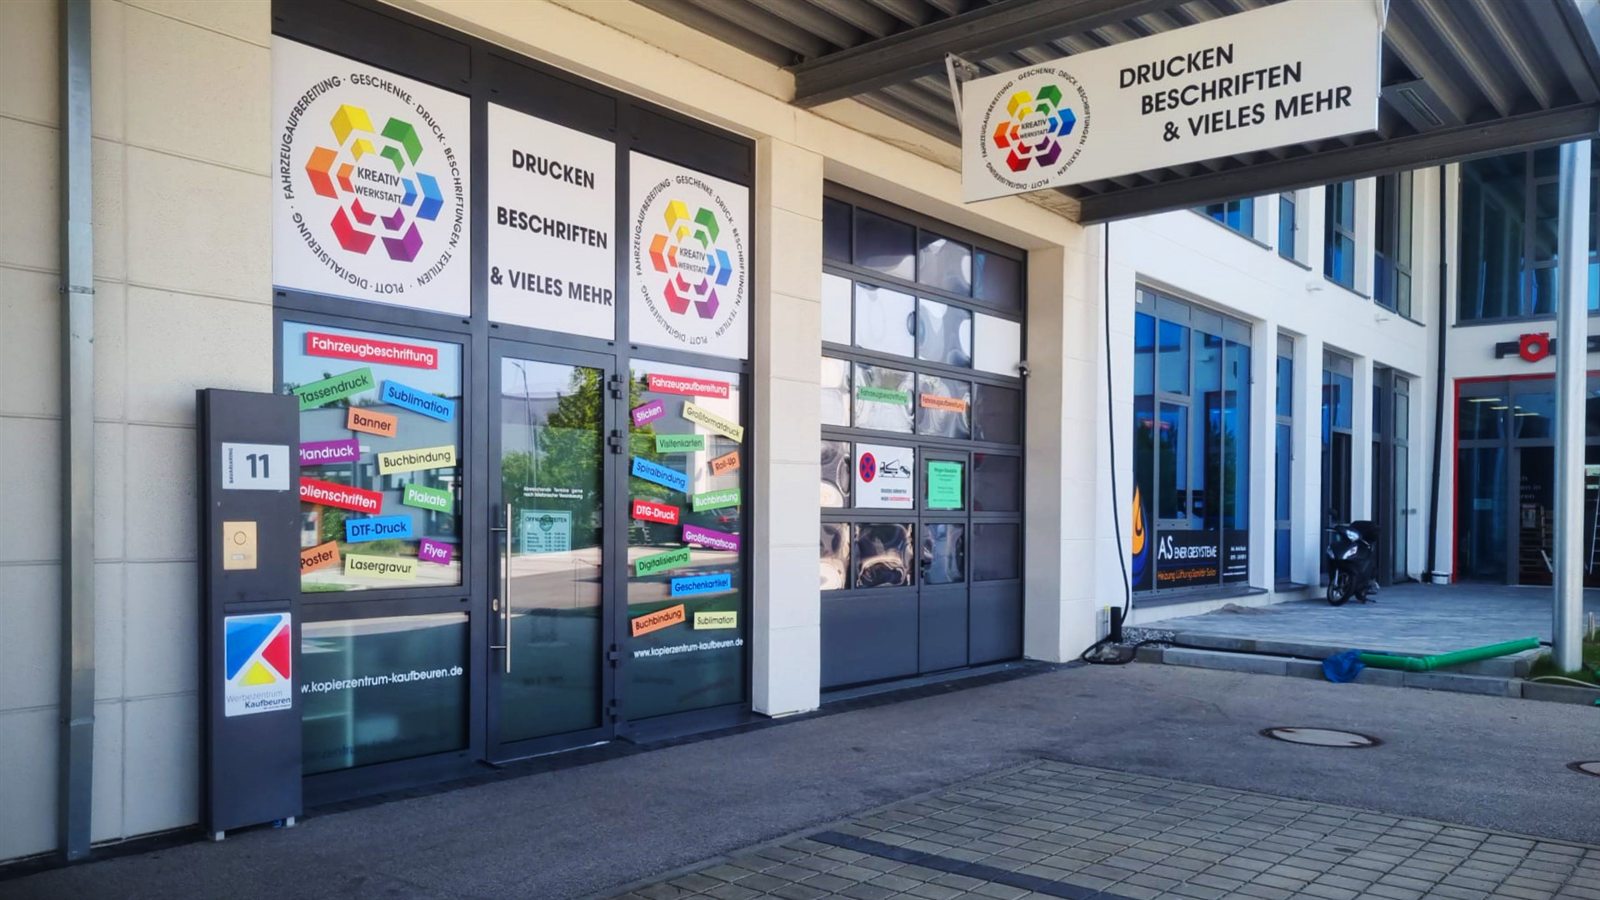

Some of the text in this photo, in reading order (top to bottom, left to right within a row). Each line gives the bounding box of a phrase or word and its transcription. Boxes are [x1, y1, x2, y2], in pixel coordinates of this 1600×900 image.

[1119, 43, 1234, 89] DRUCKEN
[1141, 61, 1302, 116] BESCHRIFTEN
[1162, 85, 1353, 143] & VIELES MEHR
[1021, 119, 1048, 130] KREATIV
[357, 166, 400, 187] KREATIV
[512, 149, 595, 190] DRUCKEN
[279, 73, 464, 294] FAHRZEUGAUFBEREITUNG GESCHENKE DRUCK BESCHRIFTUNGEN TEXTILIEN PLOTT DIGITALISIERUNG
[354, 185, 402, 204] WERKSTATT
[675, 175, 714, 198] GESCHENKE
[715, 195, 733, 220] DRUCK
[496, 206, 608, 249] BESCHRIFTEN
[679, 247, 706, 262] KREATIV
[490, 266, 613, 307] & VIELES MEHR
[312, 337, 434, 365] Fahrzeugbeschriftung
[300, 375, 369, 404] Tassendruck
[652, 377, 727, 396] Fahrzeugaufbereitung
[388, 386, 450, 417] Sublimation
[353, 413, 392, 431] Banner
[660, 439, 703, 449] Visitenkarten
[246, 454, 269, 478] 11
[383, 451, 451, 468] Buchbindung
[637, 462, 686, 489] Spiralbindung
[300, 485, 377, 509] olienschriften
[408, 489, 447, 507] Plakate
[695, 493, 738, 507] Buchbindung
[636, 505, 675, 521] DTG-Druck
[351, 521, 407, 537] DTF-Druck
[685, 531, 737, 550] Großformatscan
[1158, 535, 1173, 560] AS
[300, 549, 334, 570] Poster
[423, 543, 448, 559] Flyer
[350, 559, 412, 575] Lasergravur
[639, 552, 688, 571] Digitalisierung
[675, 579, 728, 592] Geschenkartikel
[635, 608, 682, 630] Buchbindung
[697, 616, 735, 625] Sublimation
[634, 638, 743, 658] www.kopierzentrum-kaufbeuren.de
[301, 665, 463, 694] w.kopierzentrum-kaufbeuren.de
[245, 696, 291, 709] Kaufbeuren
